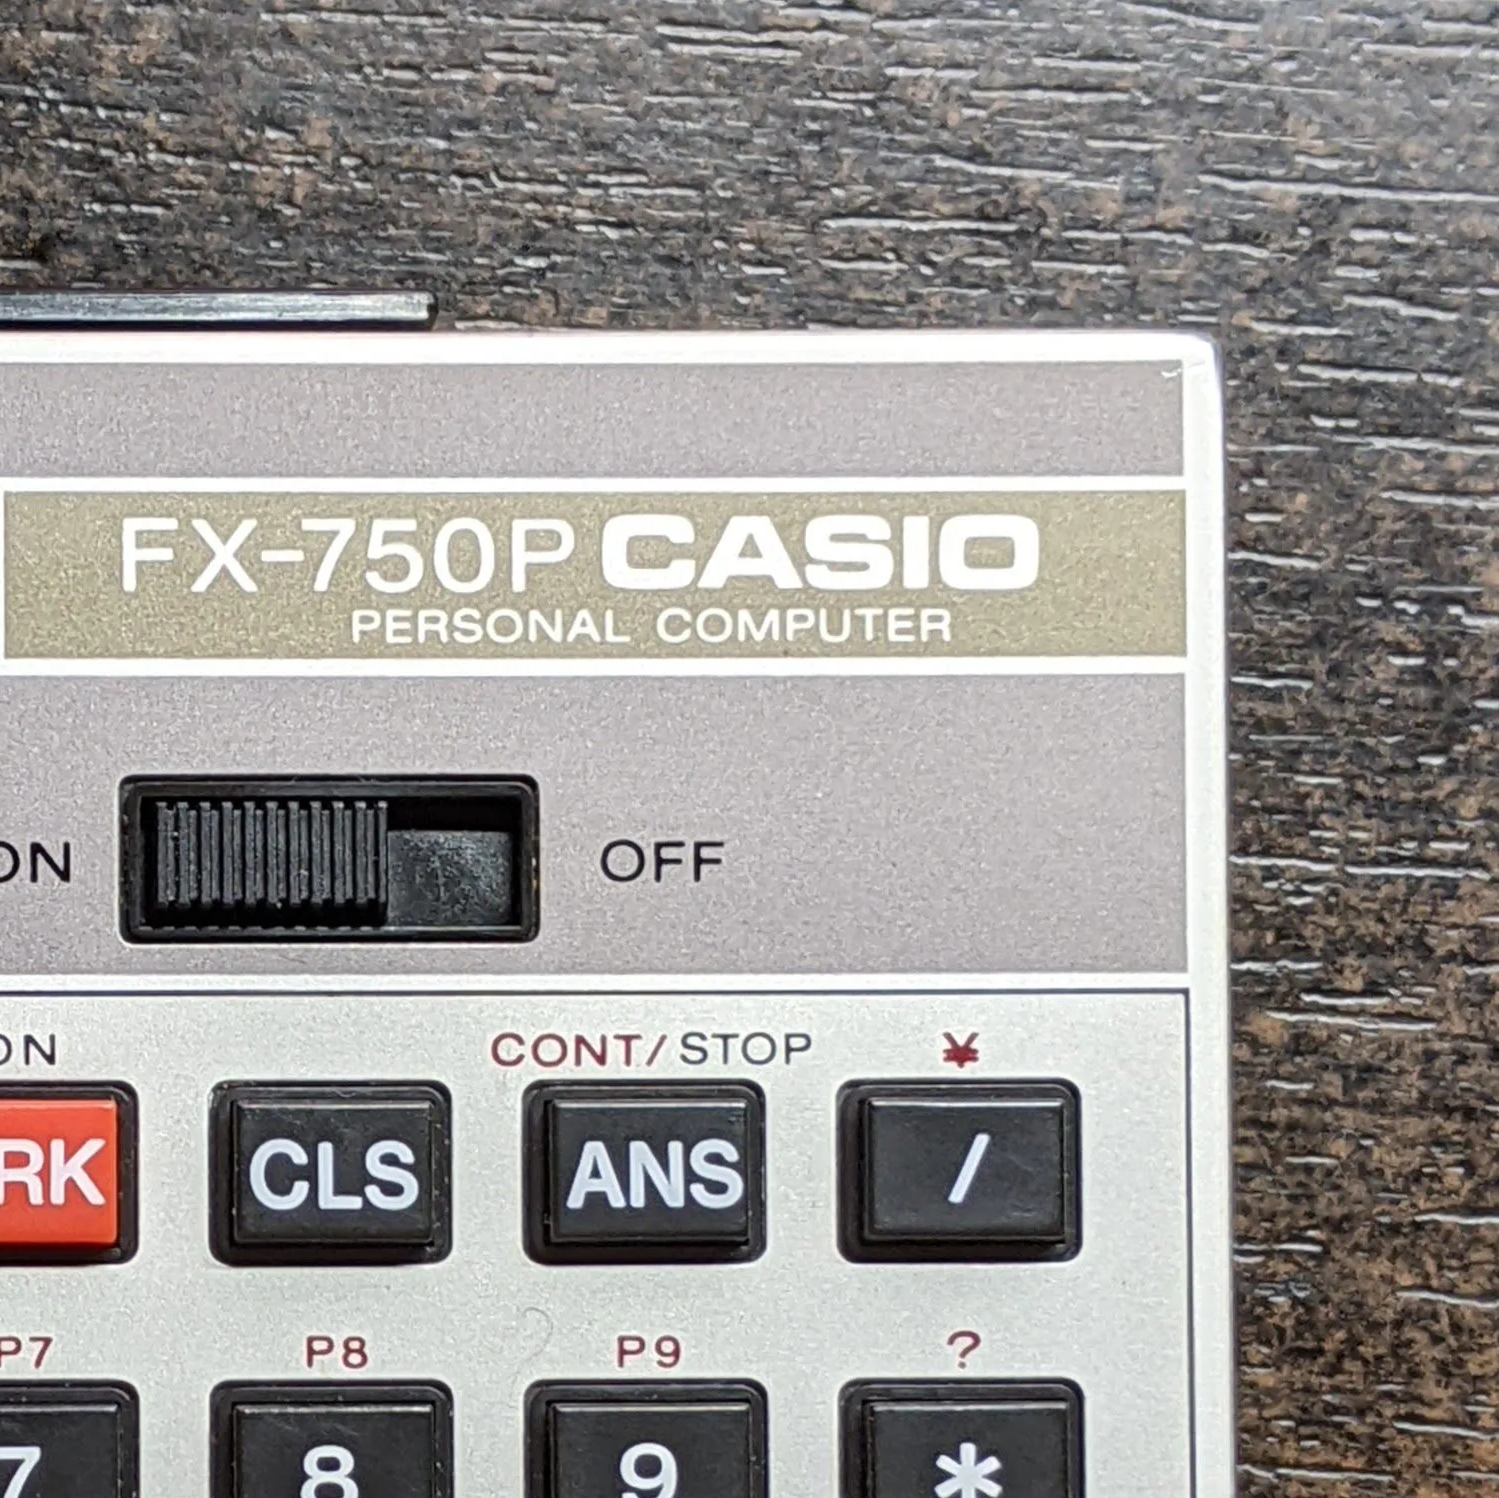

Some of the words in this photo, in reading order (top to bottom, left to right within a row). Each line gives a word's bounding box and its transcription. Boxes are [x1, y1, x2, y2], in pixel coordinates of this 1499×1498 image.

[120, 517, 576, 593] FX-750P
[600, 514, 1040, 592] CASIO
[351, 609, 629, 643] PERSONAL
[657, 607, 951, 643] COMPUTER
[600, 840, 725, 882] OFF
[943, 1033, 979, 1067] ¥
[249, 1139, 419, 1210] CLS
[566, 1138, 743, 1209] ANS
[948, 1133, 990, 1203] /
[305, 1336, 368, 1369] P8
[617, 1335, 681, 1368] P9
[947, 1331, 981, 1369] ?
